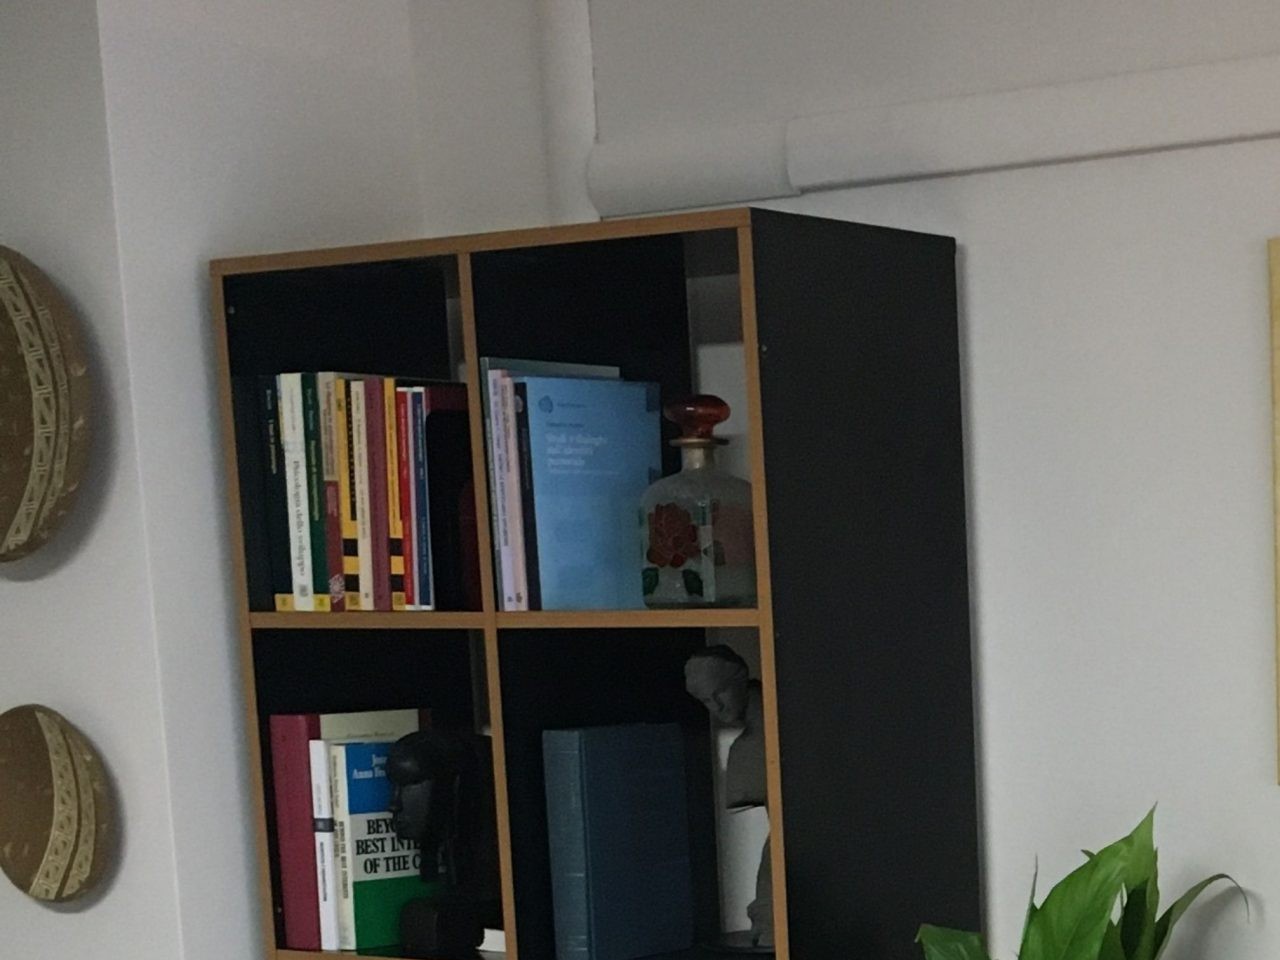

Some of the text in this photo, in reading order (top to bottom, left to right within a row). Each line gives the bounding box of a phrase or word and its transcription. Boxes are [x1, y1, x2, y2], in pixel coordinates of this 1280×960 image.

[355, 838, 387, 856] BEST
[364, 857, 381, 875] OF
[384, 855, 410, 873] THE
